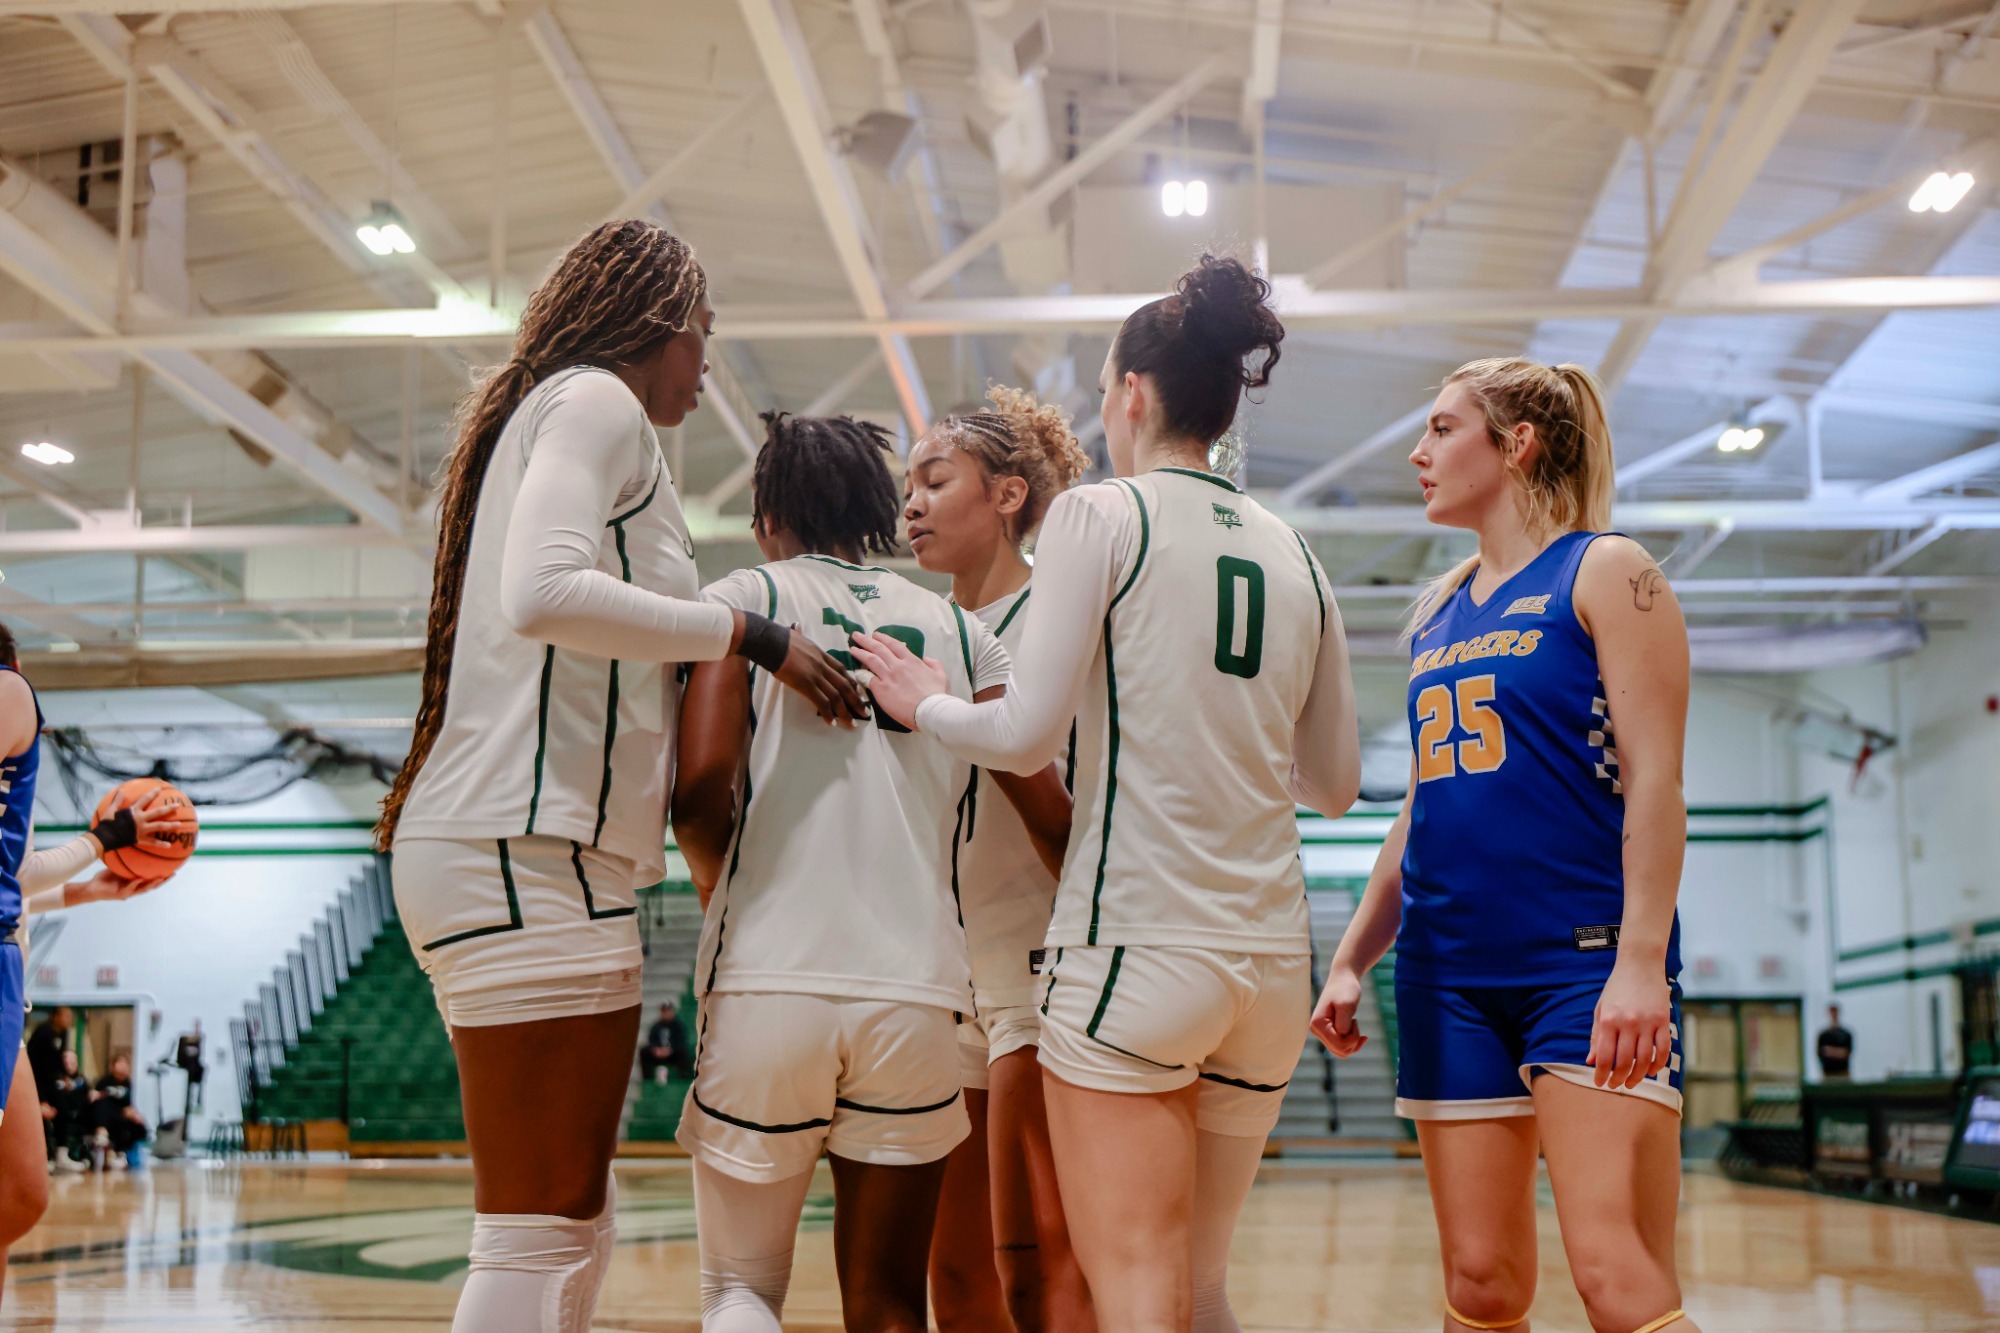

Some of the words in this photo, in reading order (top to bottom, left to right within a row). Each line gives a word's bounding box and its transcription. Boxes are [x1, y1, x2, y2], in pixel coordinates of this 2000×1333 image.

[1215, 555, 1265, 679] 0
[1507, 594, 1551, 613] NEC
[1416, 674, 1507, 784] 25
